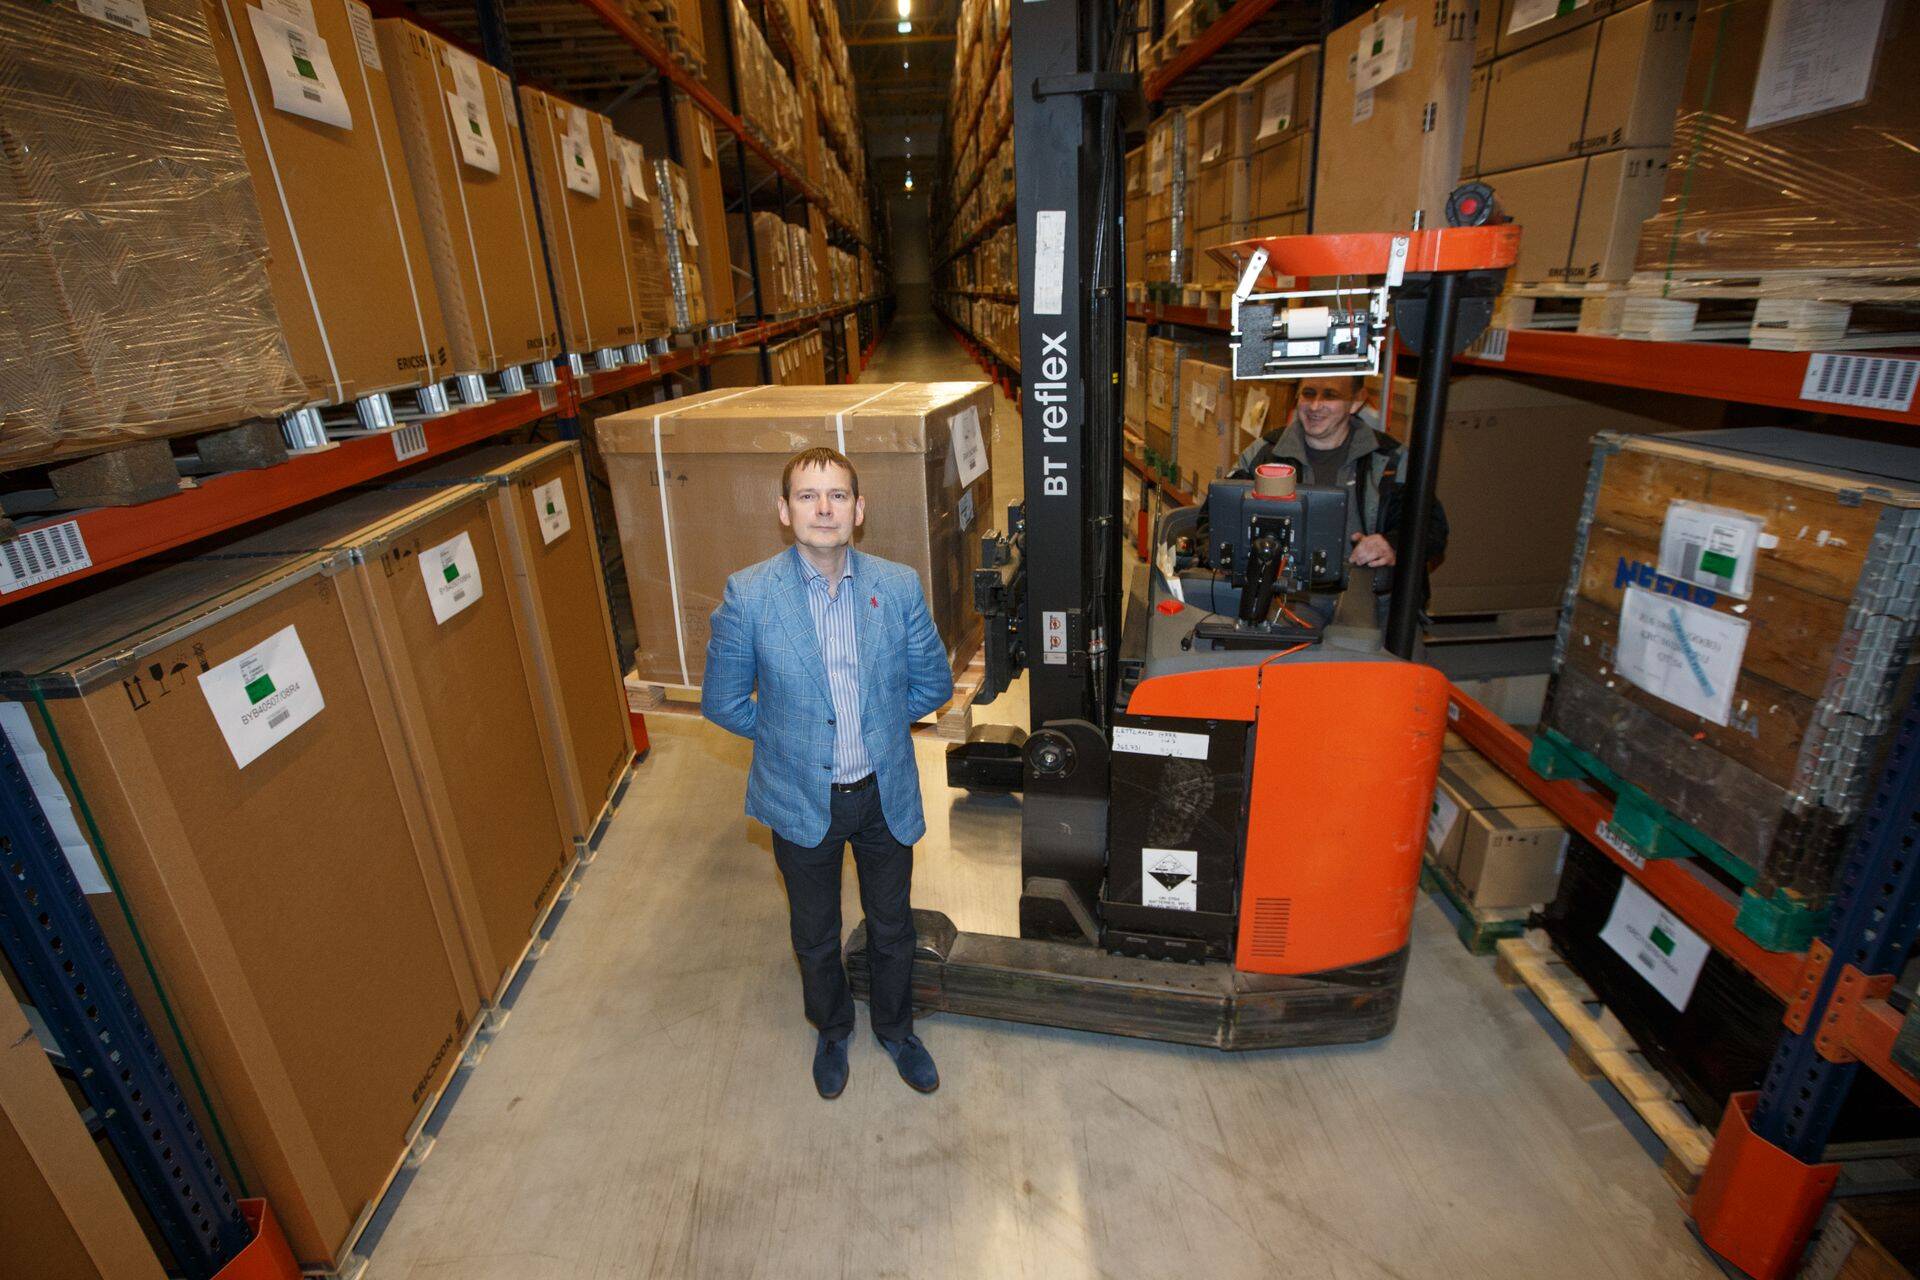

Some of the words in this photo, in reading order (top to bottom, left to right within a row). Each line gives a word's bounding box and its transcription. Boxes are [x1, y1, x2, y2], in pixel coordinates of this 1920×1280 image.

[397, 353, 436, 370] ERICSSN
[1034, 331, 1068, 443] reflex
[1043, 456, 1068, 496] BT
[412, 1033, 453, 1104] ERICSSON
